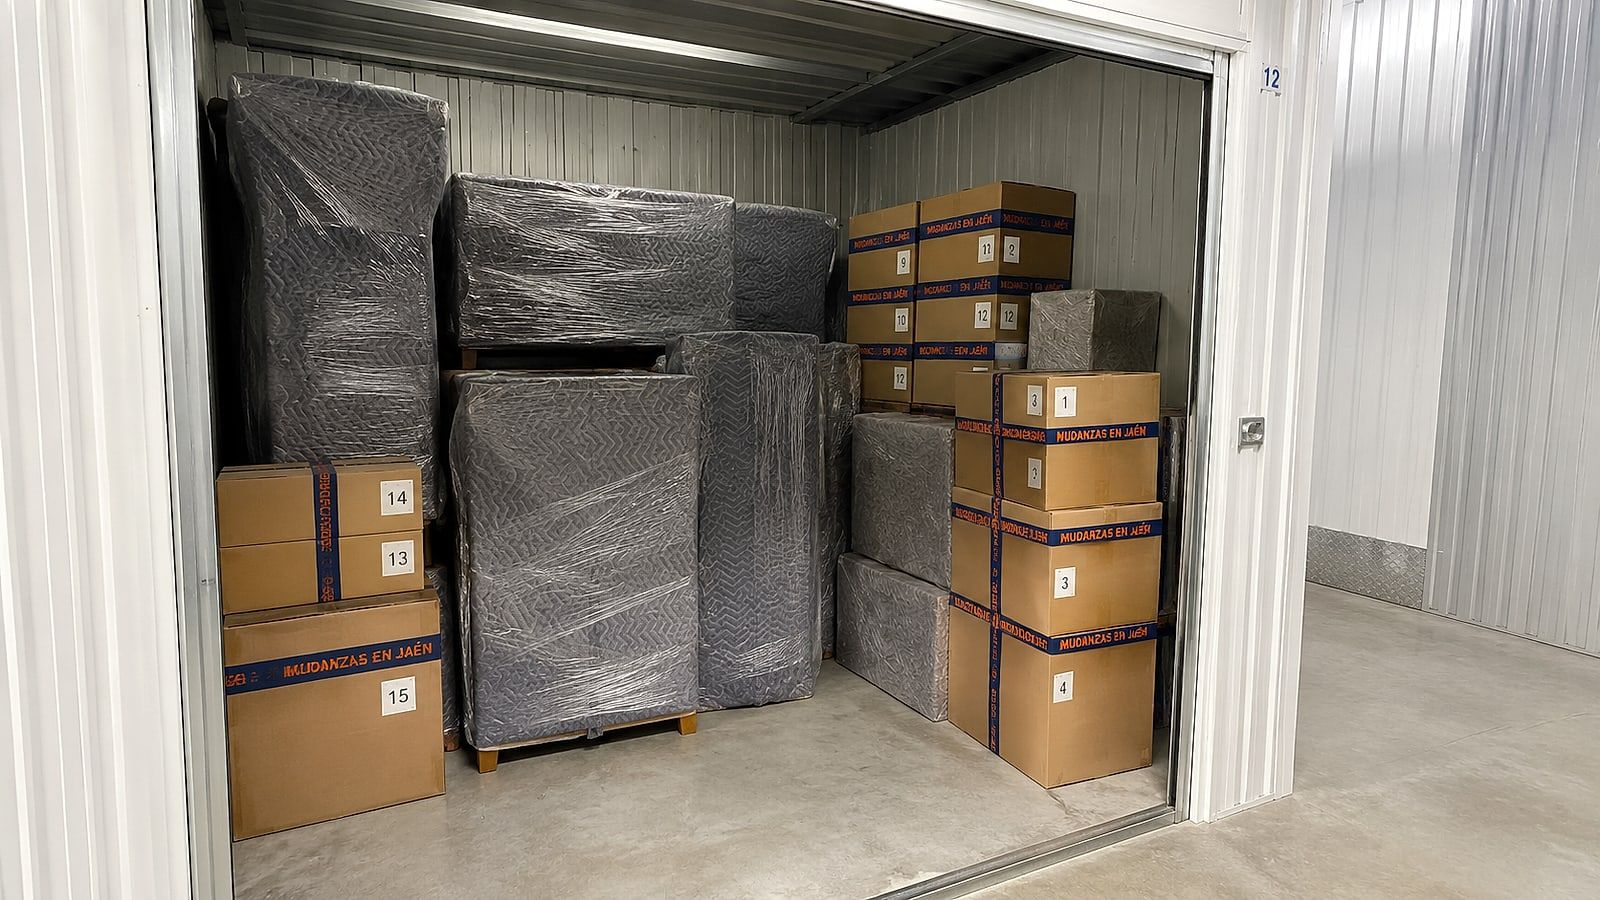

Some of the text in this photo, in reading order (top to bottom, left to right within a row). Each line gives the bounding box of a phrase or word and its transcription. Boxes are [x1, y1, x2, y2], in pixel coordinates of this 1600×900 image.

[1264, 67, 1280, 89] 12
[901, 257, 906, 269] 9
[897, 314, 907, 326] 10
[978, 309, 989, 322] 12
[1004, 310, 1014, 323] 12
[896, 373, 905, 384] 12
[1062, 395, 1068, 409] 1
[387, 490, 408, 506] 14
[388, 551, 408, 567] 13
[1061, 576, 1069, 590] 3
[371, 648, 392, 663] EN
[395, 641, 433, 660] JAÉN
[1059, 681, 1067, 695] 4
[388, 688, 409, 705] 15
